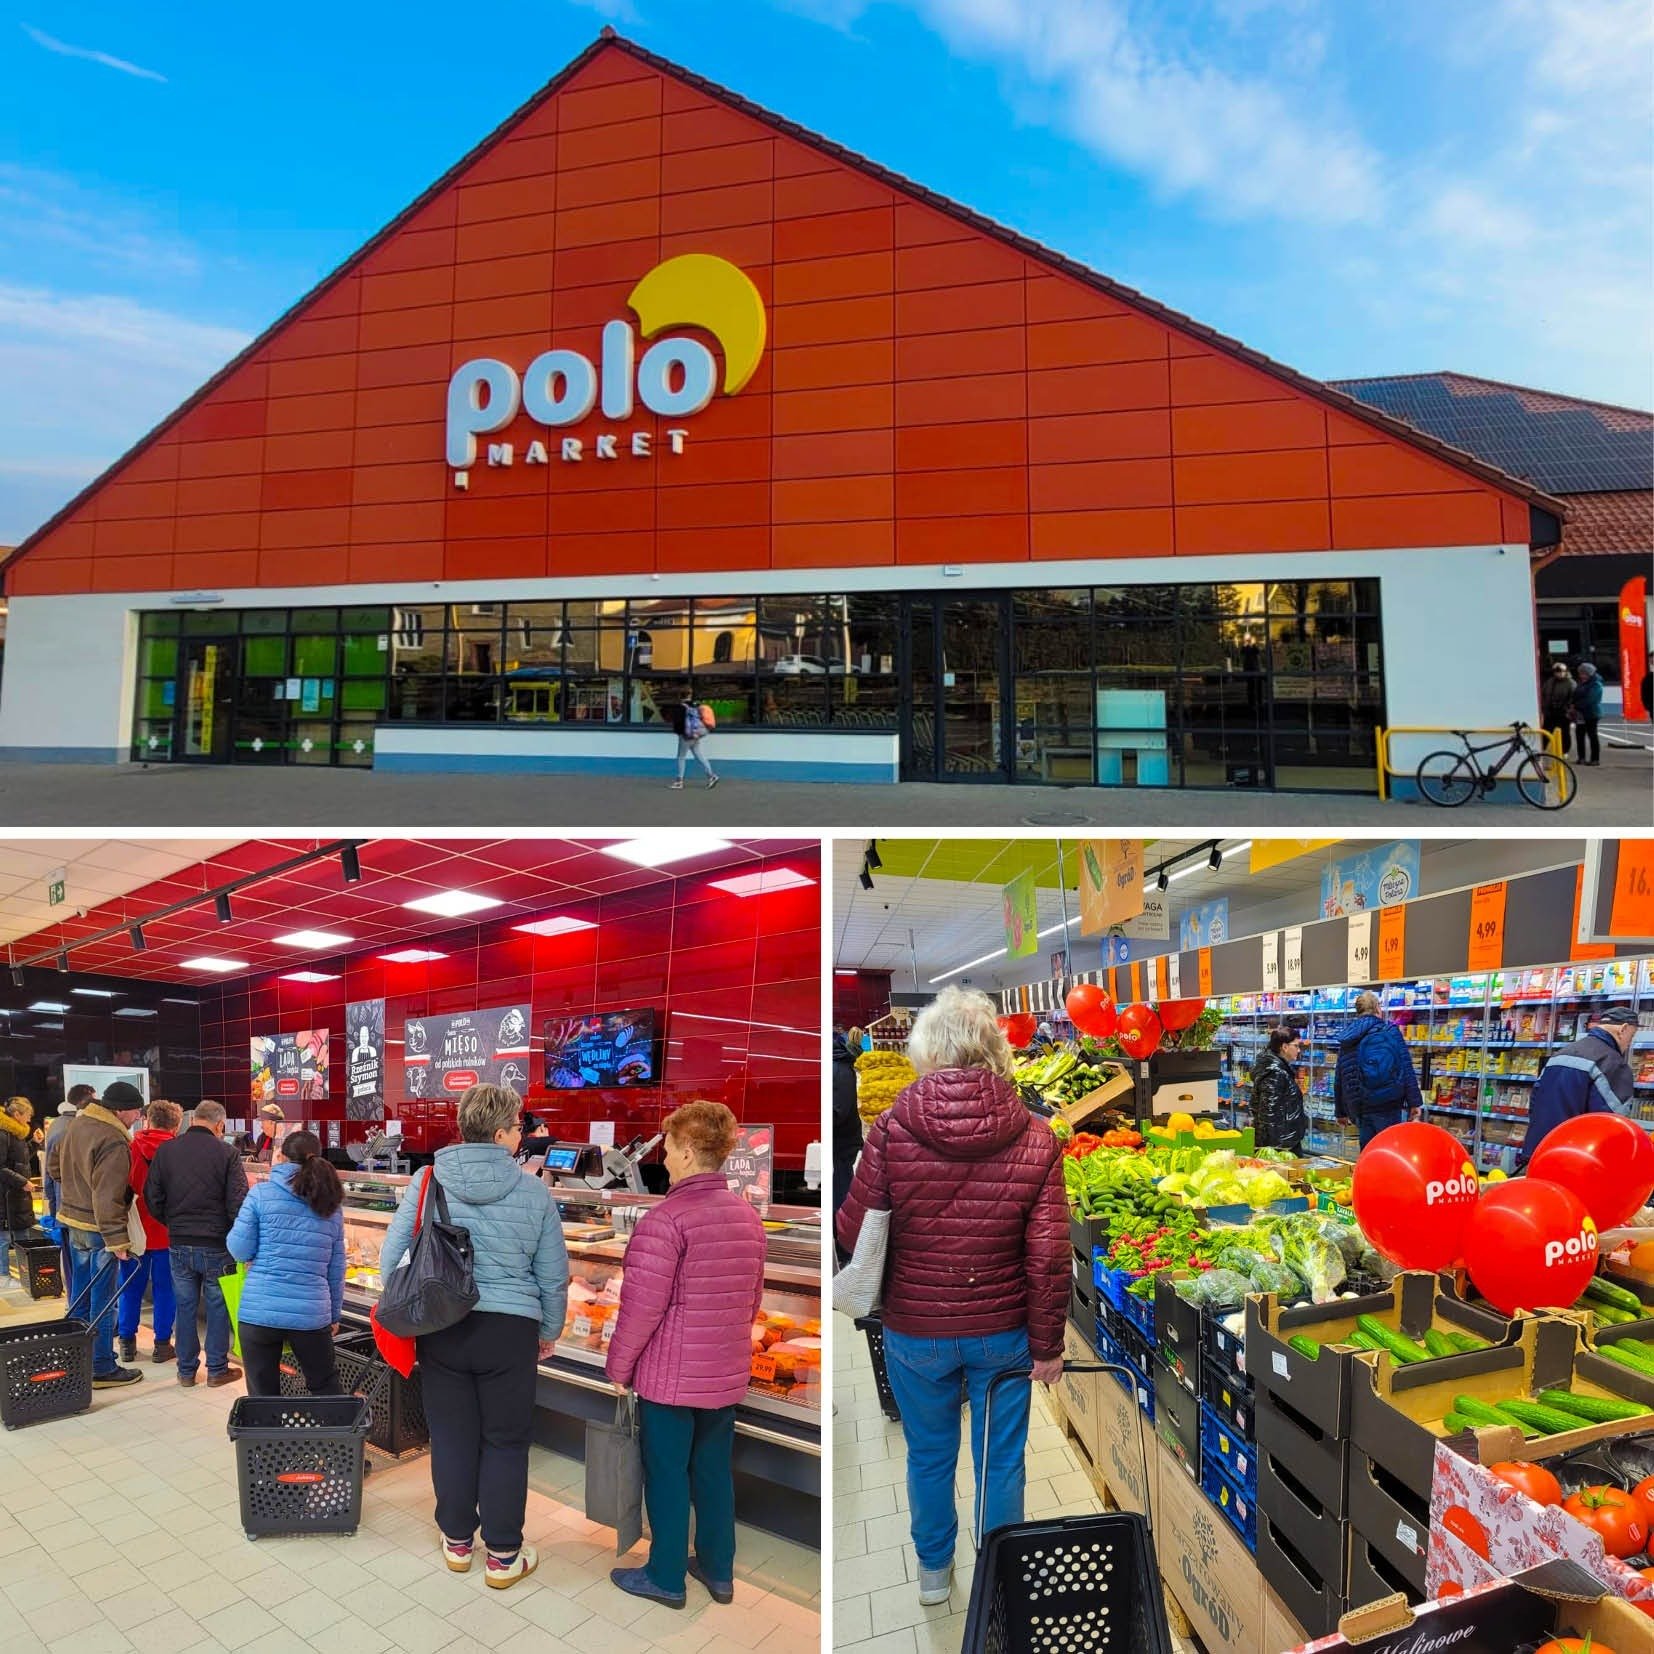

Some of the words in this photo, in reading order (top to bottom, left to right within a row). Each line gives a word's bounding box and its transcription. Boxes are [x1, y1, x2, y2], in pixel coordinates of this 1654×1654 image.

[447, 319, 717, 468] polo
[488, 428, 689, 467] MARKET
[1144, 901, 1163, 912] AGA
[1354, 947, 1368, 961] 4.99
[1119, 1032, 1138, 1041] polo
[445, 1034, 477, 1056] MIĘSO
[351, 1059, 379, 1075] Rzeźnik
[350, 1070, 378, 1085] Szymon
[729, 1159, 751, 1171] LADA
[1426, 1173, 1476, 1206] polo
[1545, 1230, 1597, 1268] polo
